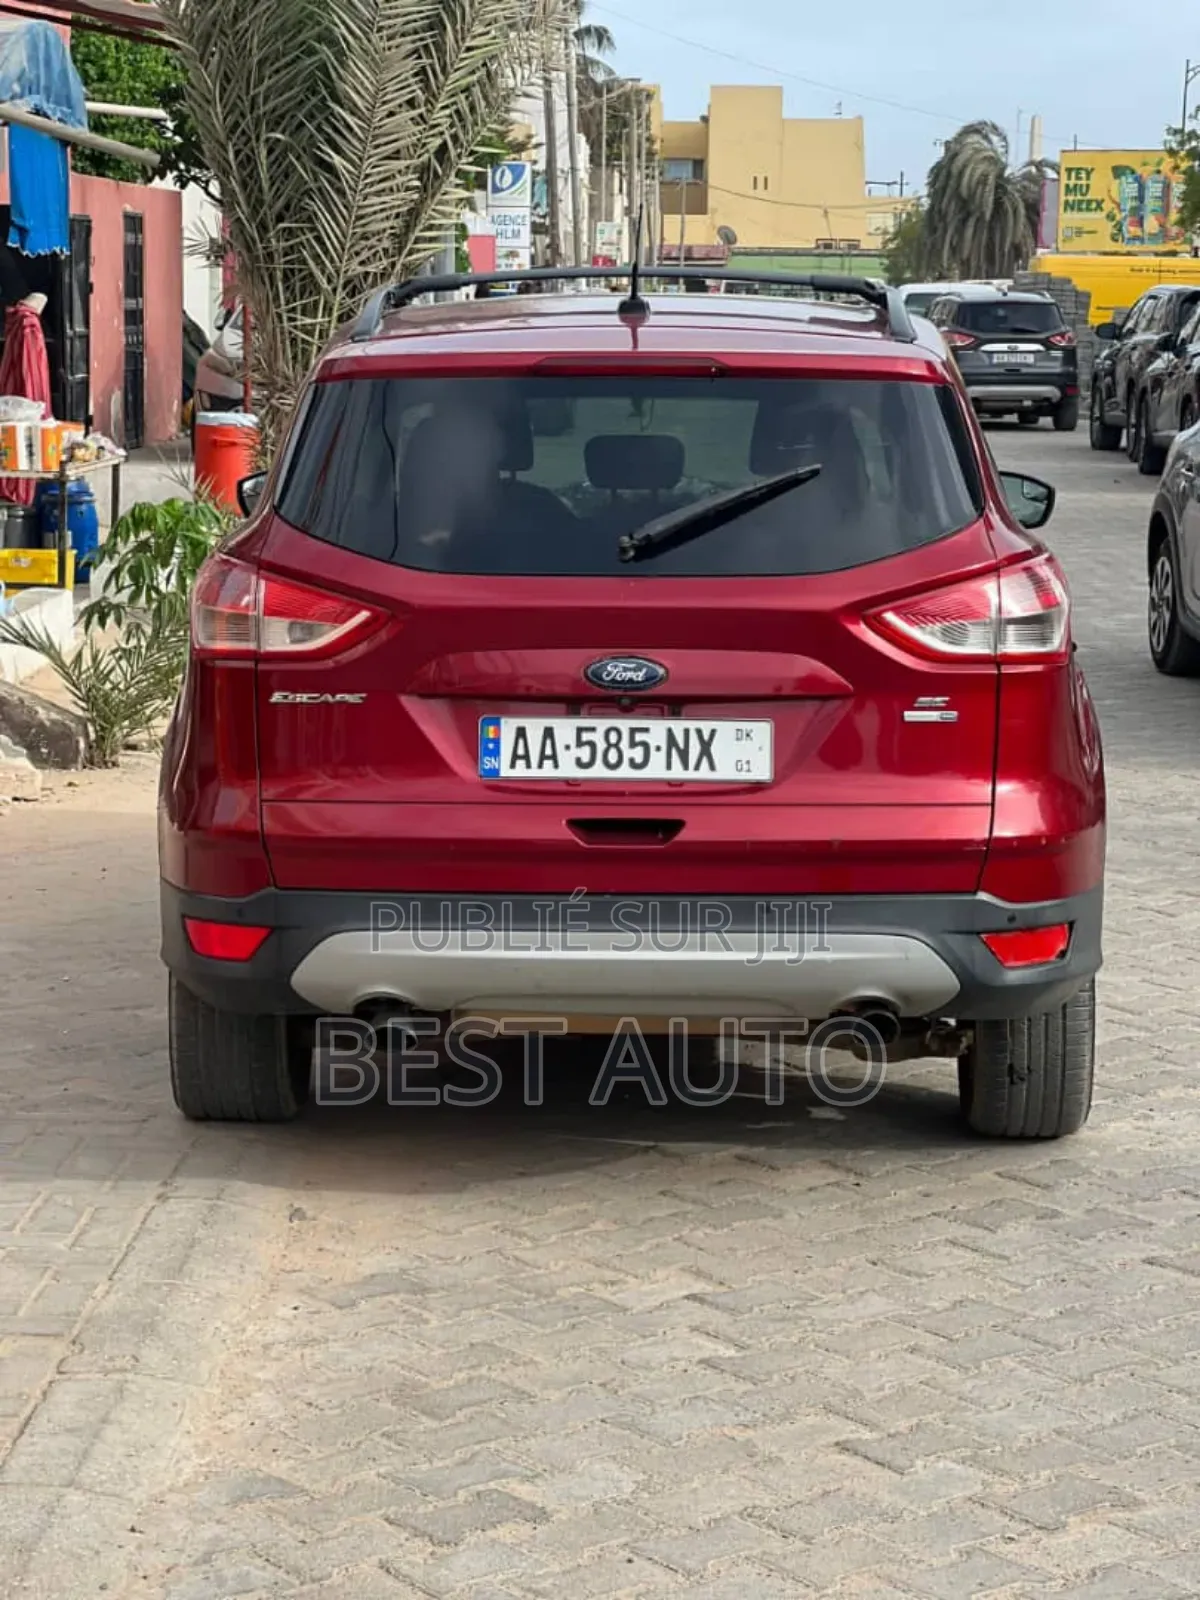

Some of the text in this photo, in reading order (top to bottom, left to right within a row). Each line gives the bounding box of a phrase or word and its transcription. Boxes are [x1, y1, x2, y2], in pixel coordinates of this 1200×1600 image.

[1065, 167, 1095, 181] TEY
[1065, 184, 1090, 197] MU
[1064, 199, 1105, 213] NEEX
[491, 214, 528, 226] AGENCE
[496, 227, 521, 240] HLM
[602, 662, 647, 682] Ford
[735, 728, 754, 742] DK
[483, 757, 499, 769] SN
